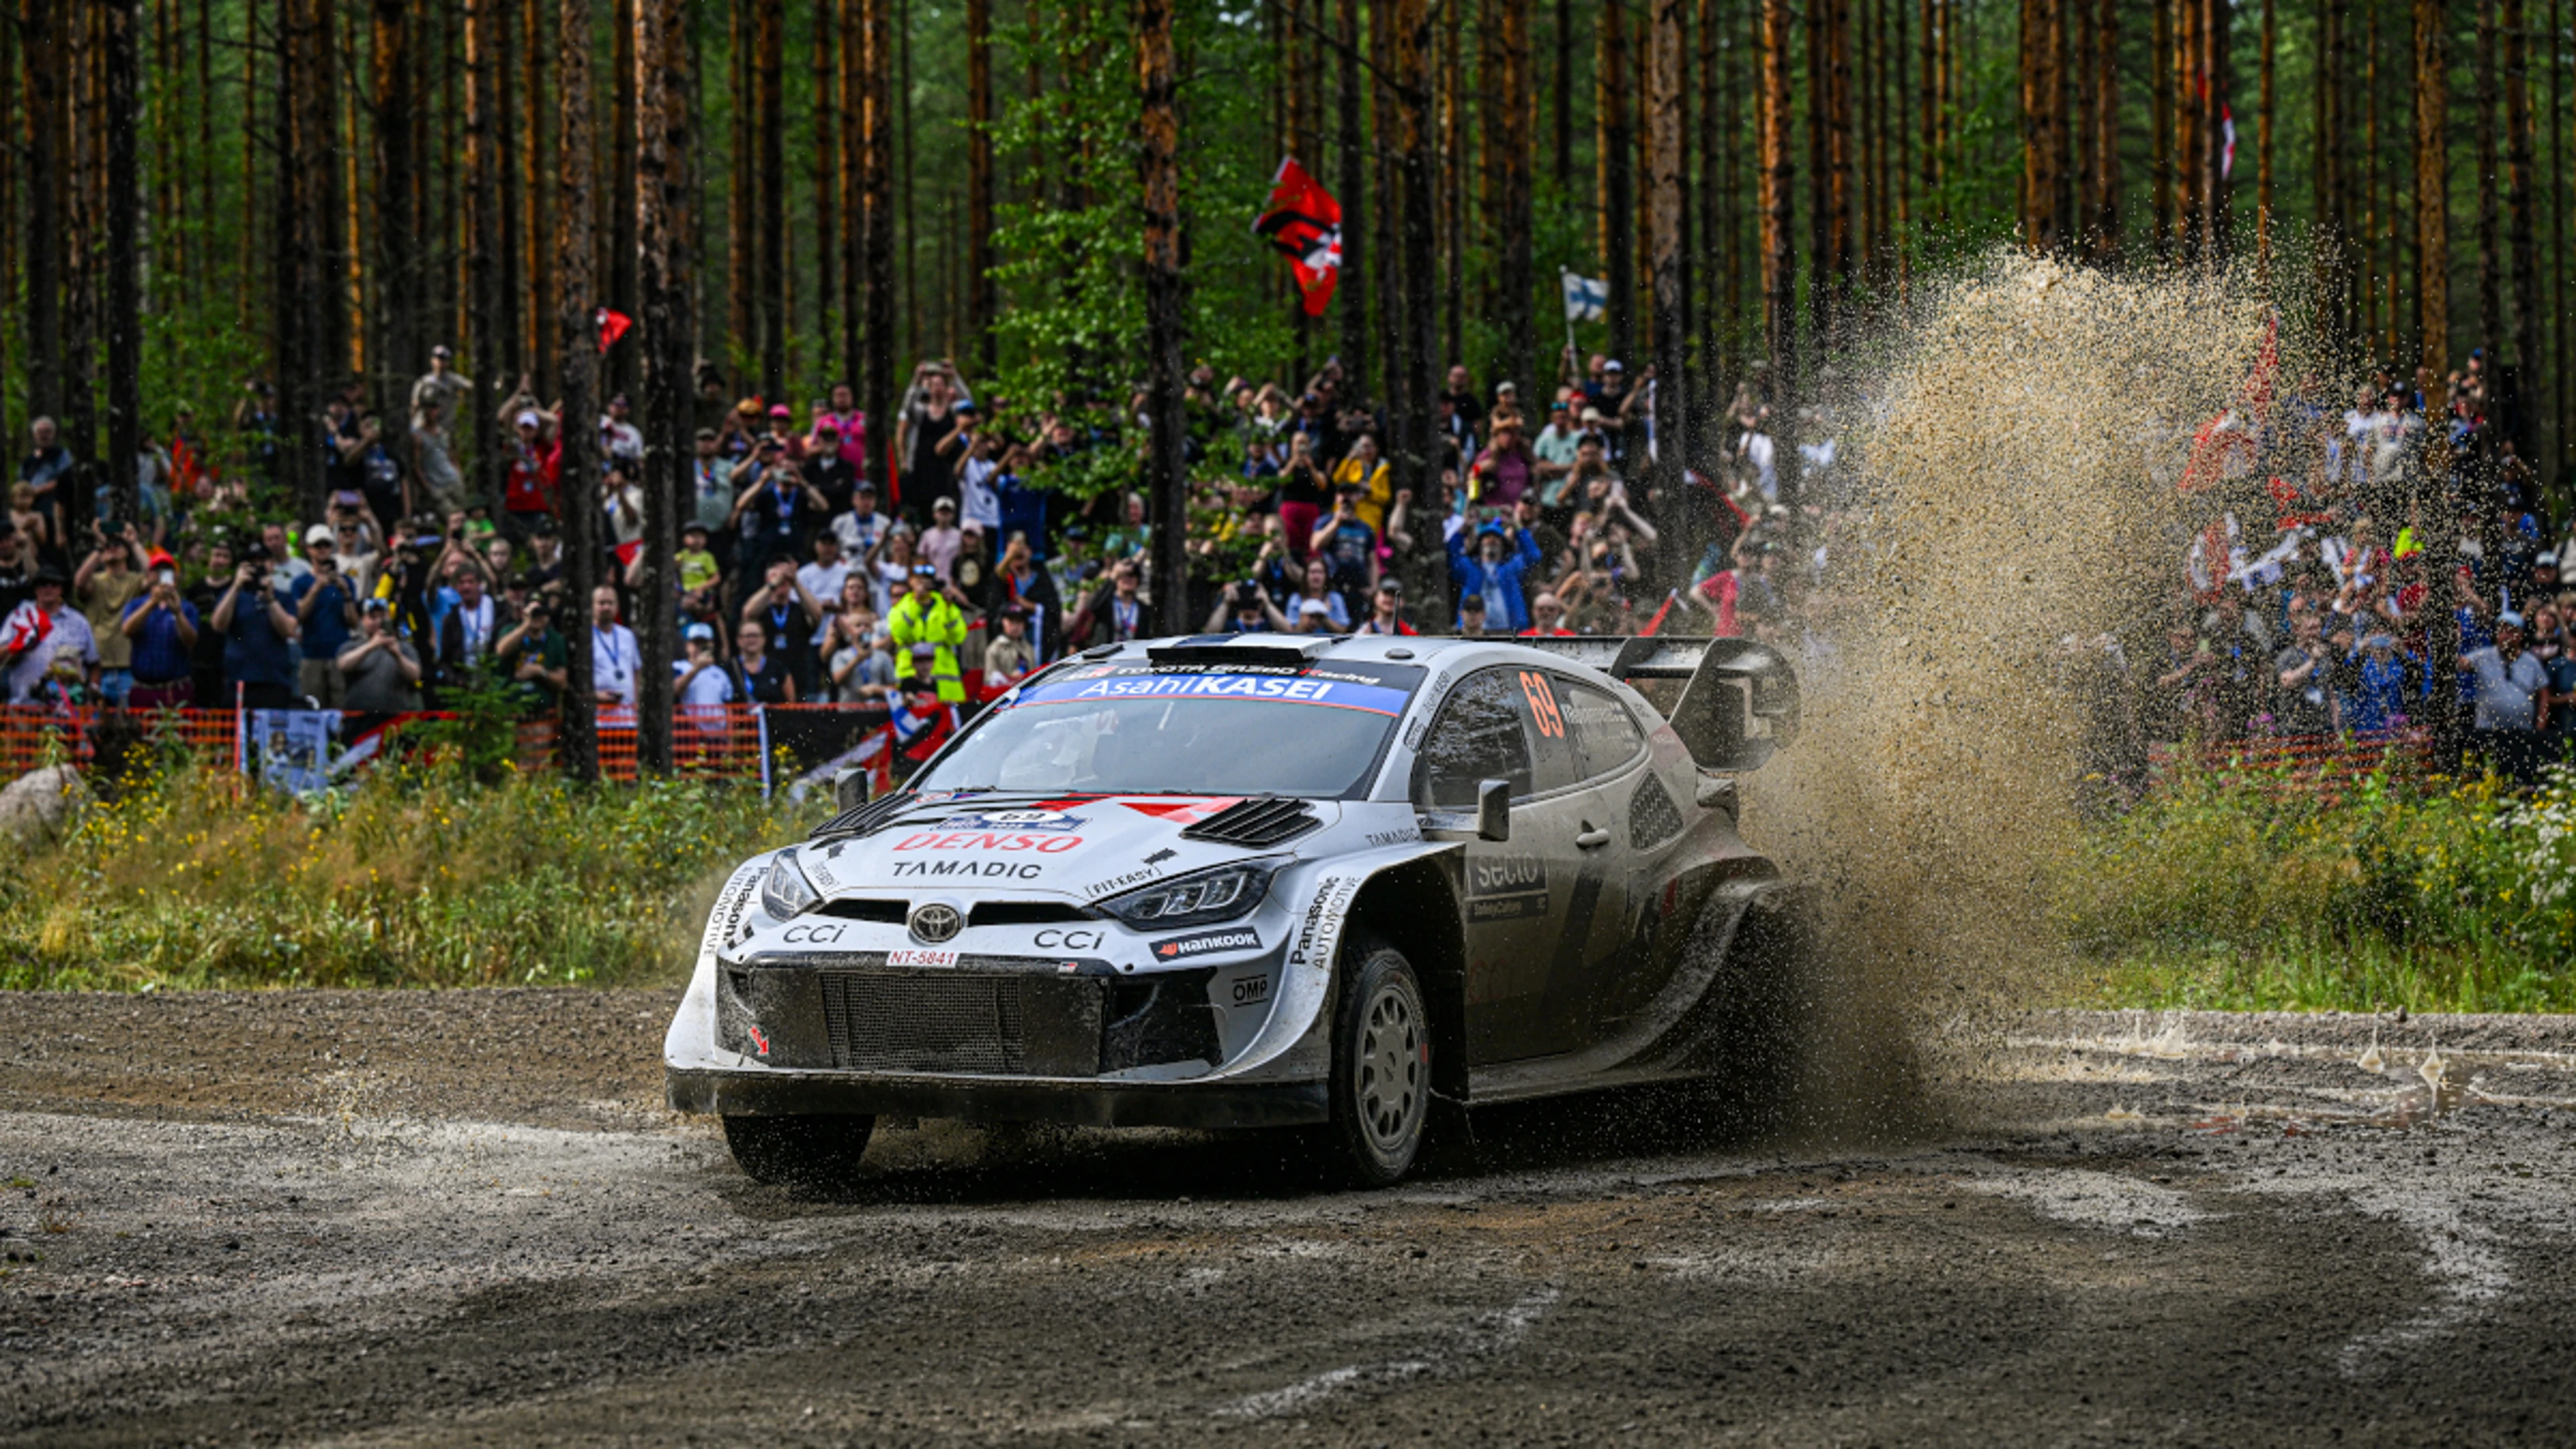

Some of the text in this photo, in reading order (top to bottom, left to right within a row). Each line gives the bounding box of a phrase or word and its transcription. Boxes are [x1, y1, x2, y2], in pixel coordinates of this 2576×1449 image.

[1117, 665, 1205, 674] TOYOTA
[1211, 664, 1296, 675] GAZOO
[1299, 667, 1381, 685] Racing
[1519, 672, 1564, 739] 69
[892, 833, 1084, 853] DENSO
[892, 860, 1042, 879] TAMADIC
[723, 867, 770, 941] Panason
[1289, 875, 1340, 965] Panasonic
[1313, 876, 1362, 969] AUTOMOTIVE
[890, 952, 955, 965] NT-5841
[1234, 979, 1267, 1001] OMP
